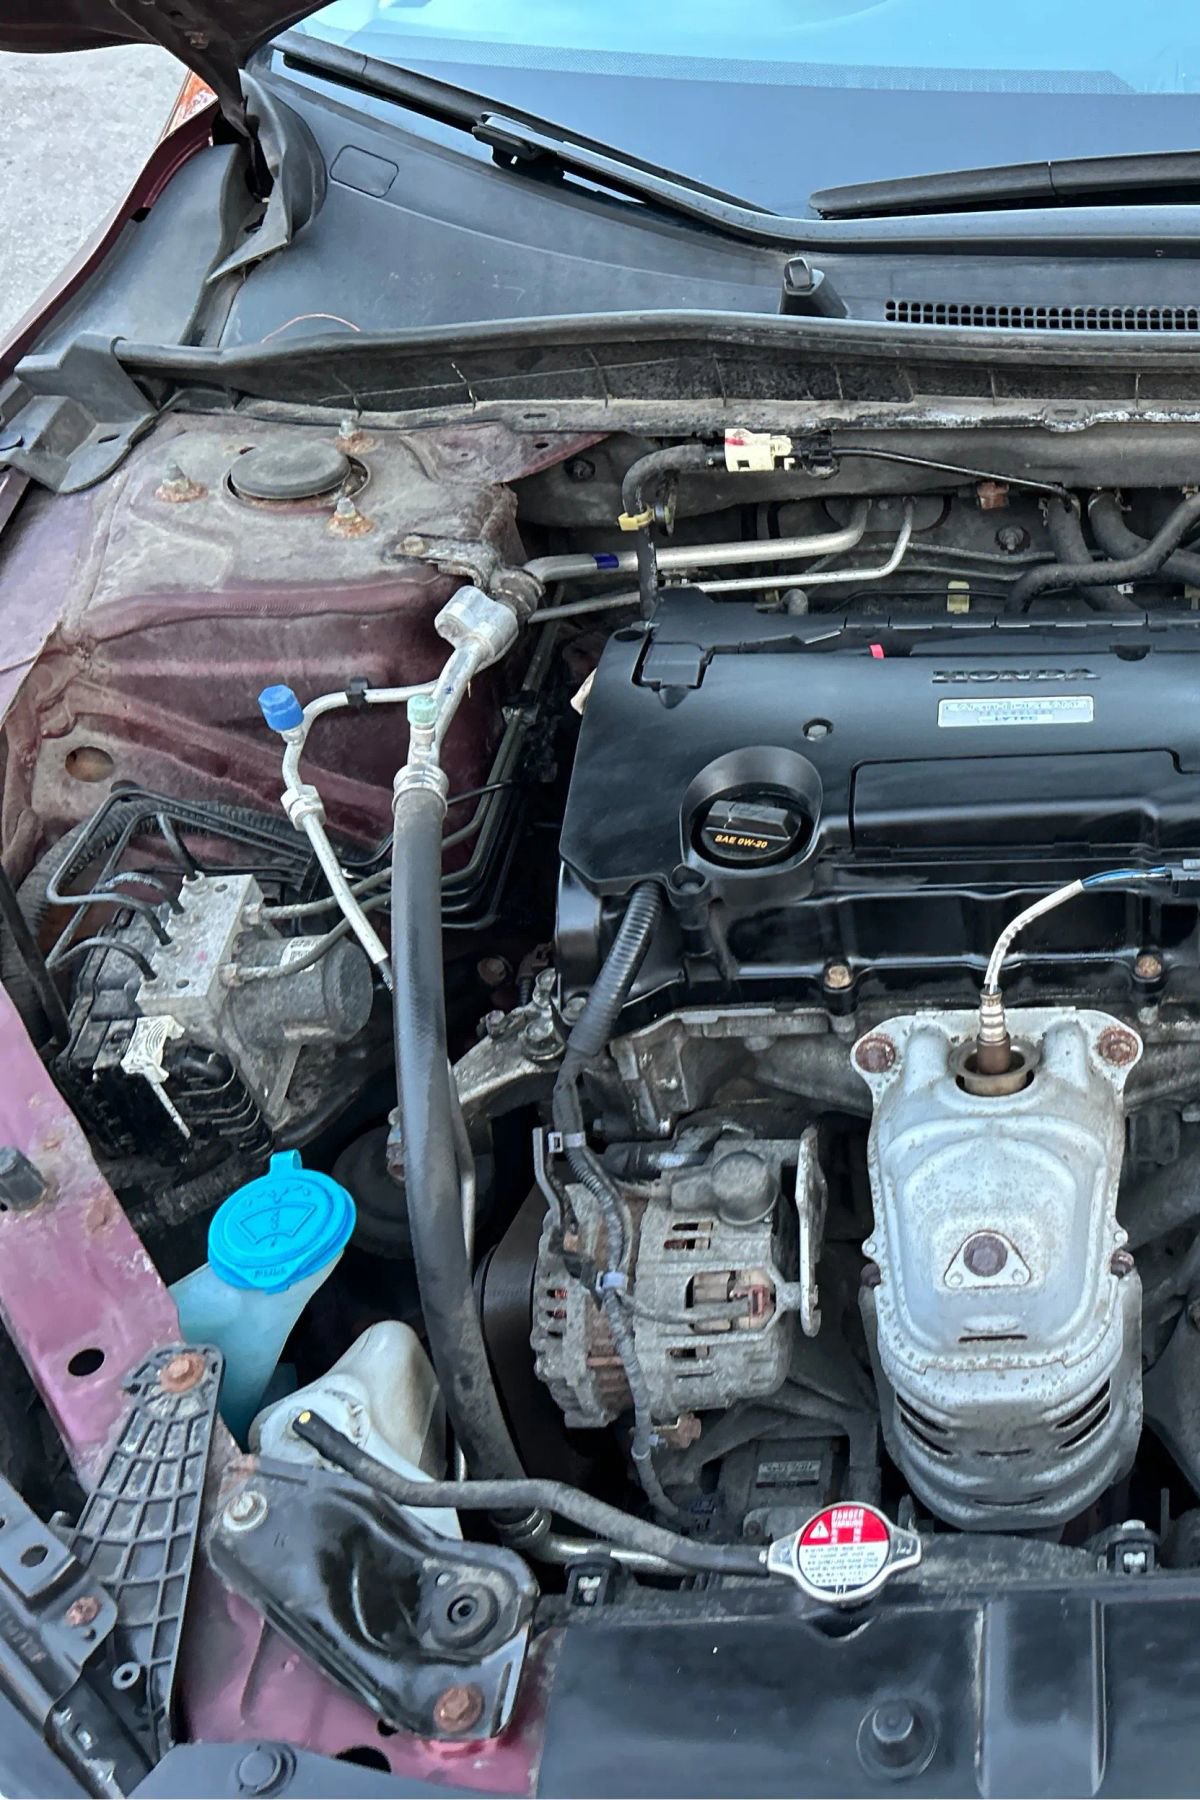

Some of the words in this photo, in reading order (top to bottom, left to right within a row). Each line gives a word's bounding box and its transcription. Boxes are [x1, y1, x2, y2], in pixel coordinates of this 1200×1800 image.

[932, 668, 1101, 683] HONDA
[715, 834, 736, 845] SAE
[737, 838, 768, 849] 0W-20
[832, 1509, 864, 1521] DANGER
